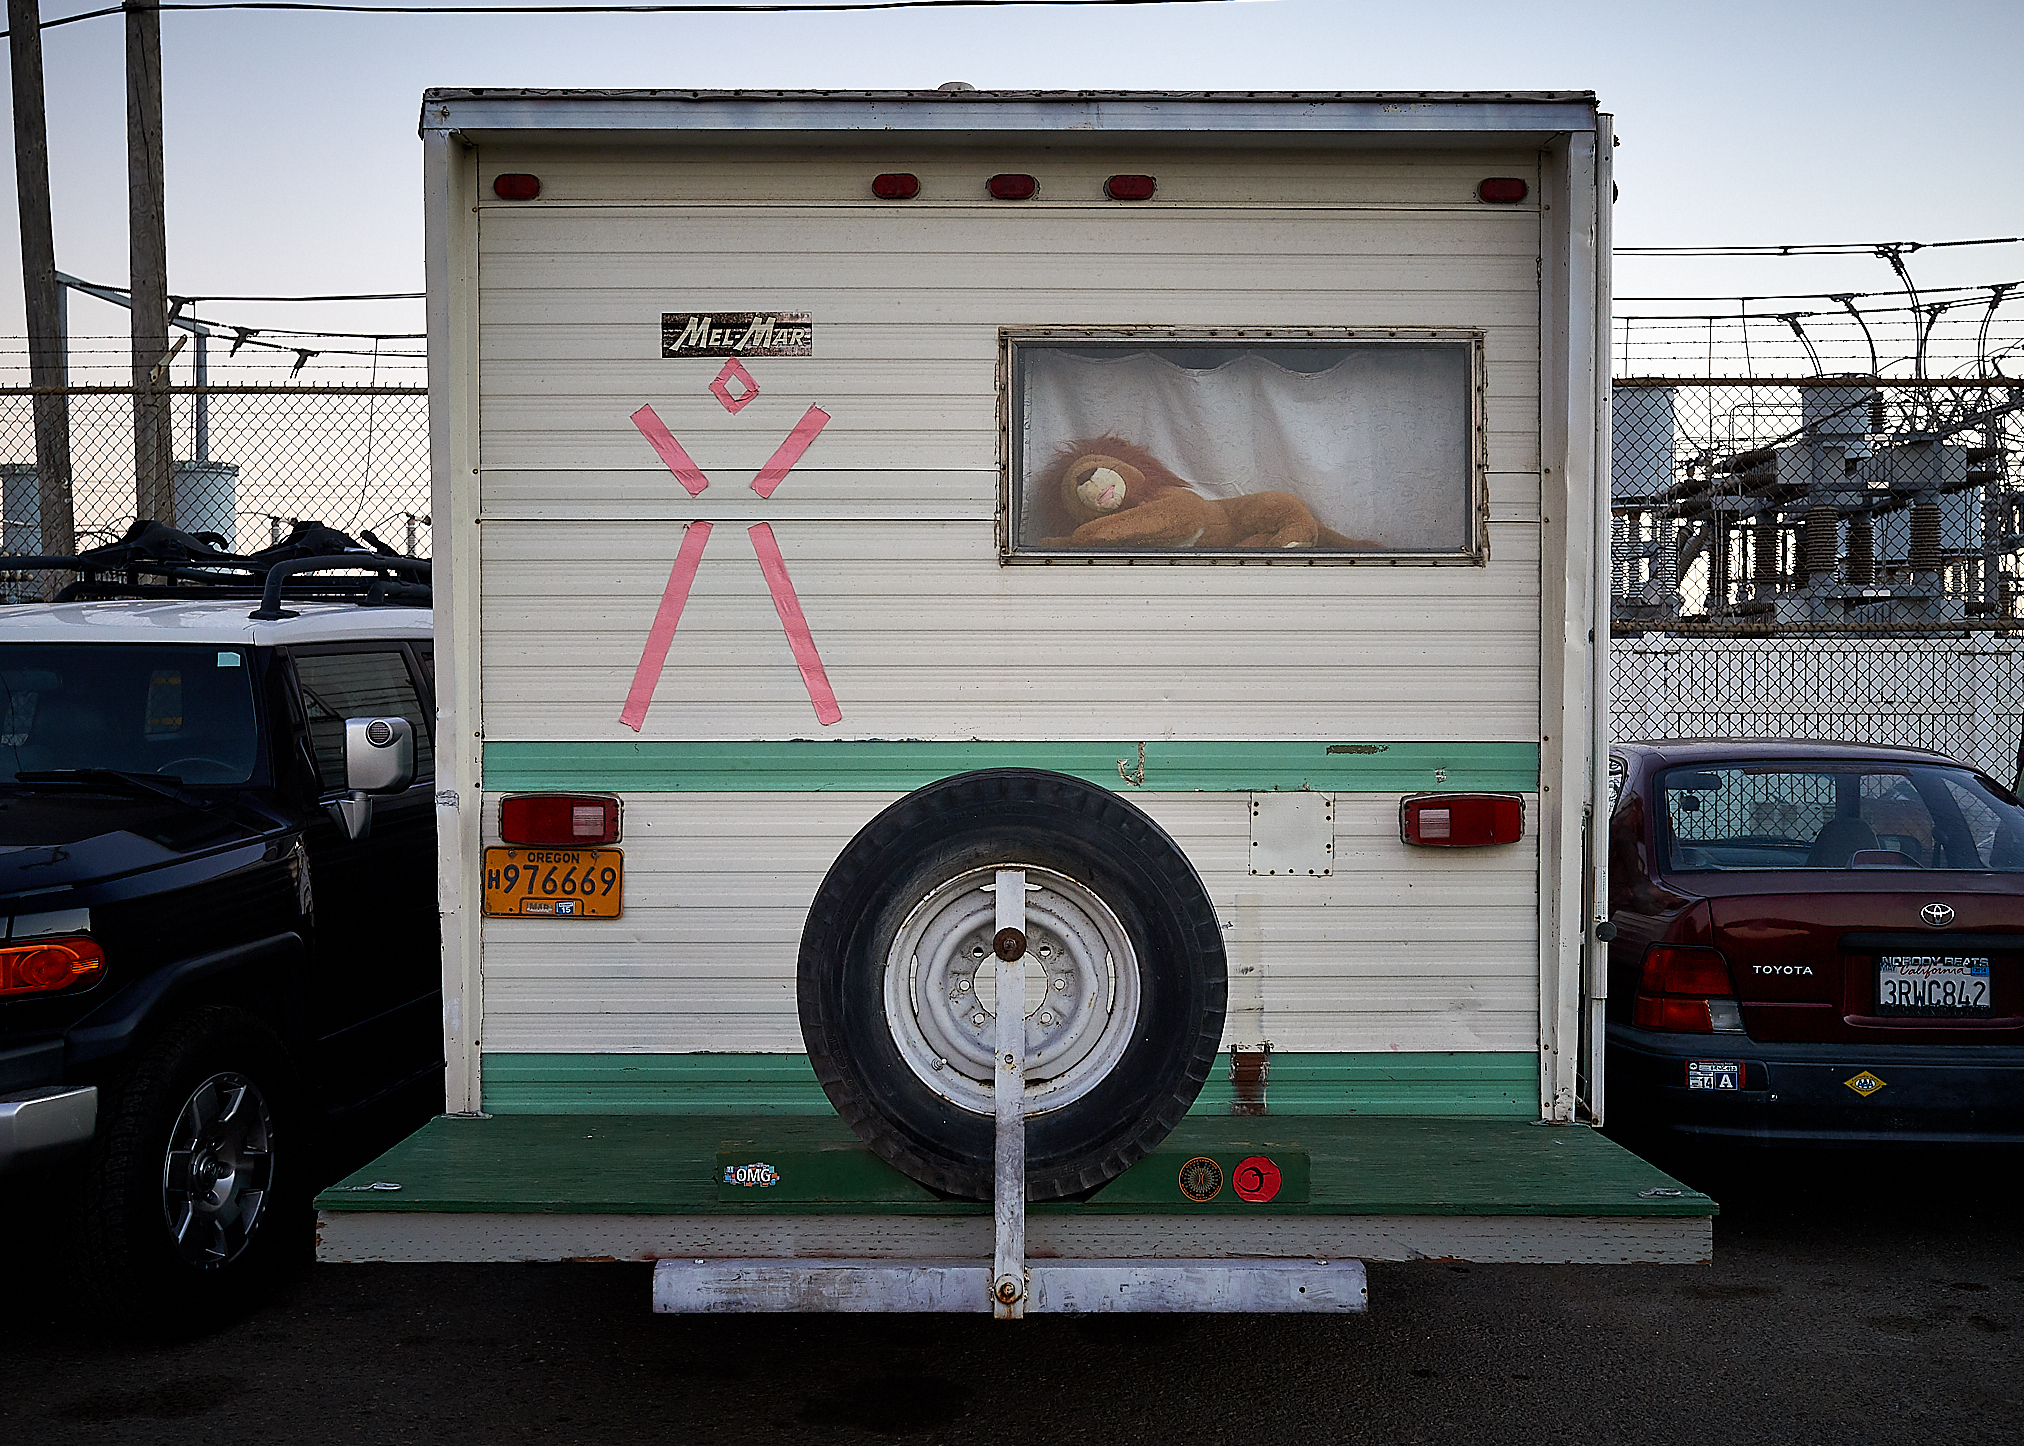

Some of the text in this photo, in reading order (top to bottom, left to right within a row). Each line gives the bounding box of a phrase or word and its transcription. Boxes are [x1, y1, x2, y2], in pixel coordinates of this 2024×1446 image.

[669, 316, 806, 351] MEL-MAR
[527, 852, 580, 863] OREGON
[487, 864, 617, 896] H976669
[561, 906, 571, 914] 15
[1881, 956, 1989, 967] NOBODY BEATS
[1752, 965, 1813, 975] TOYOTA
[1900, 964, 1966, 979] California
[1884, 979, 1987, 1006] 3RWC842
[1719, 1073, 1734, 1088] A
[1857, 1078, 1874, 1089] AAA
[736, 1168, 771, 1182] OMG
